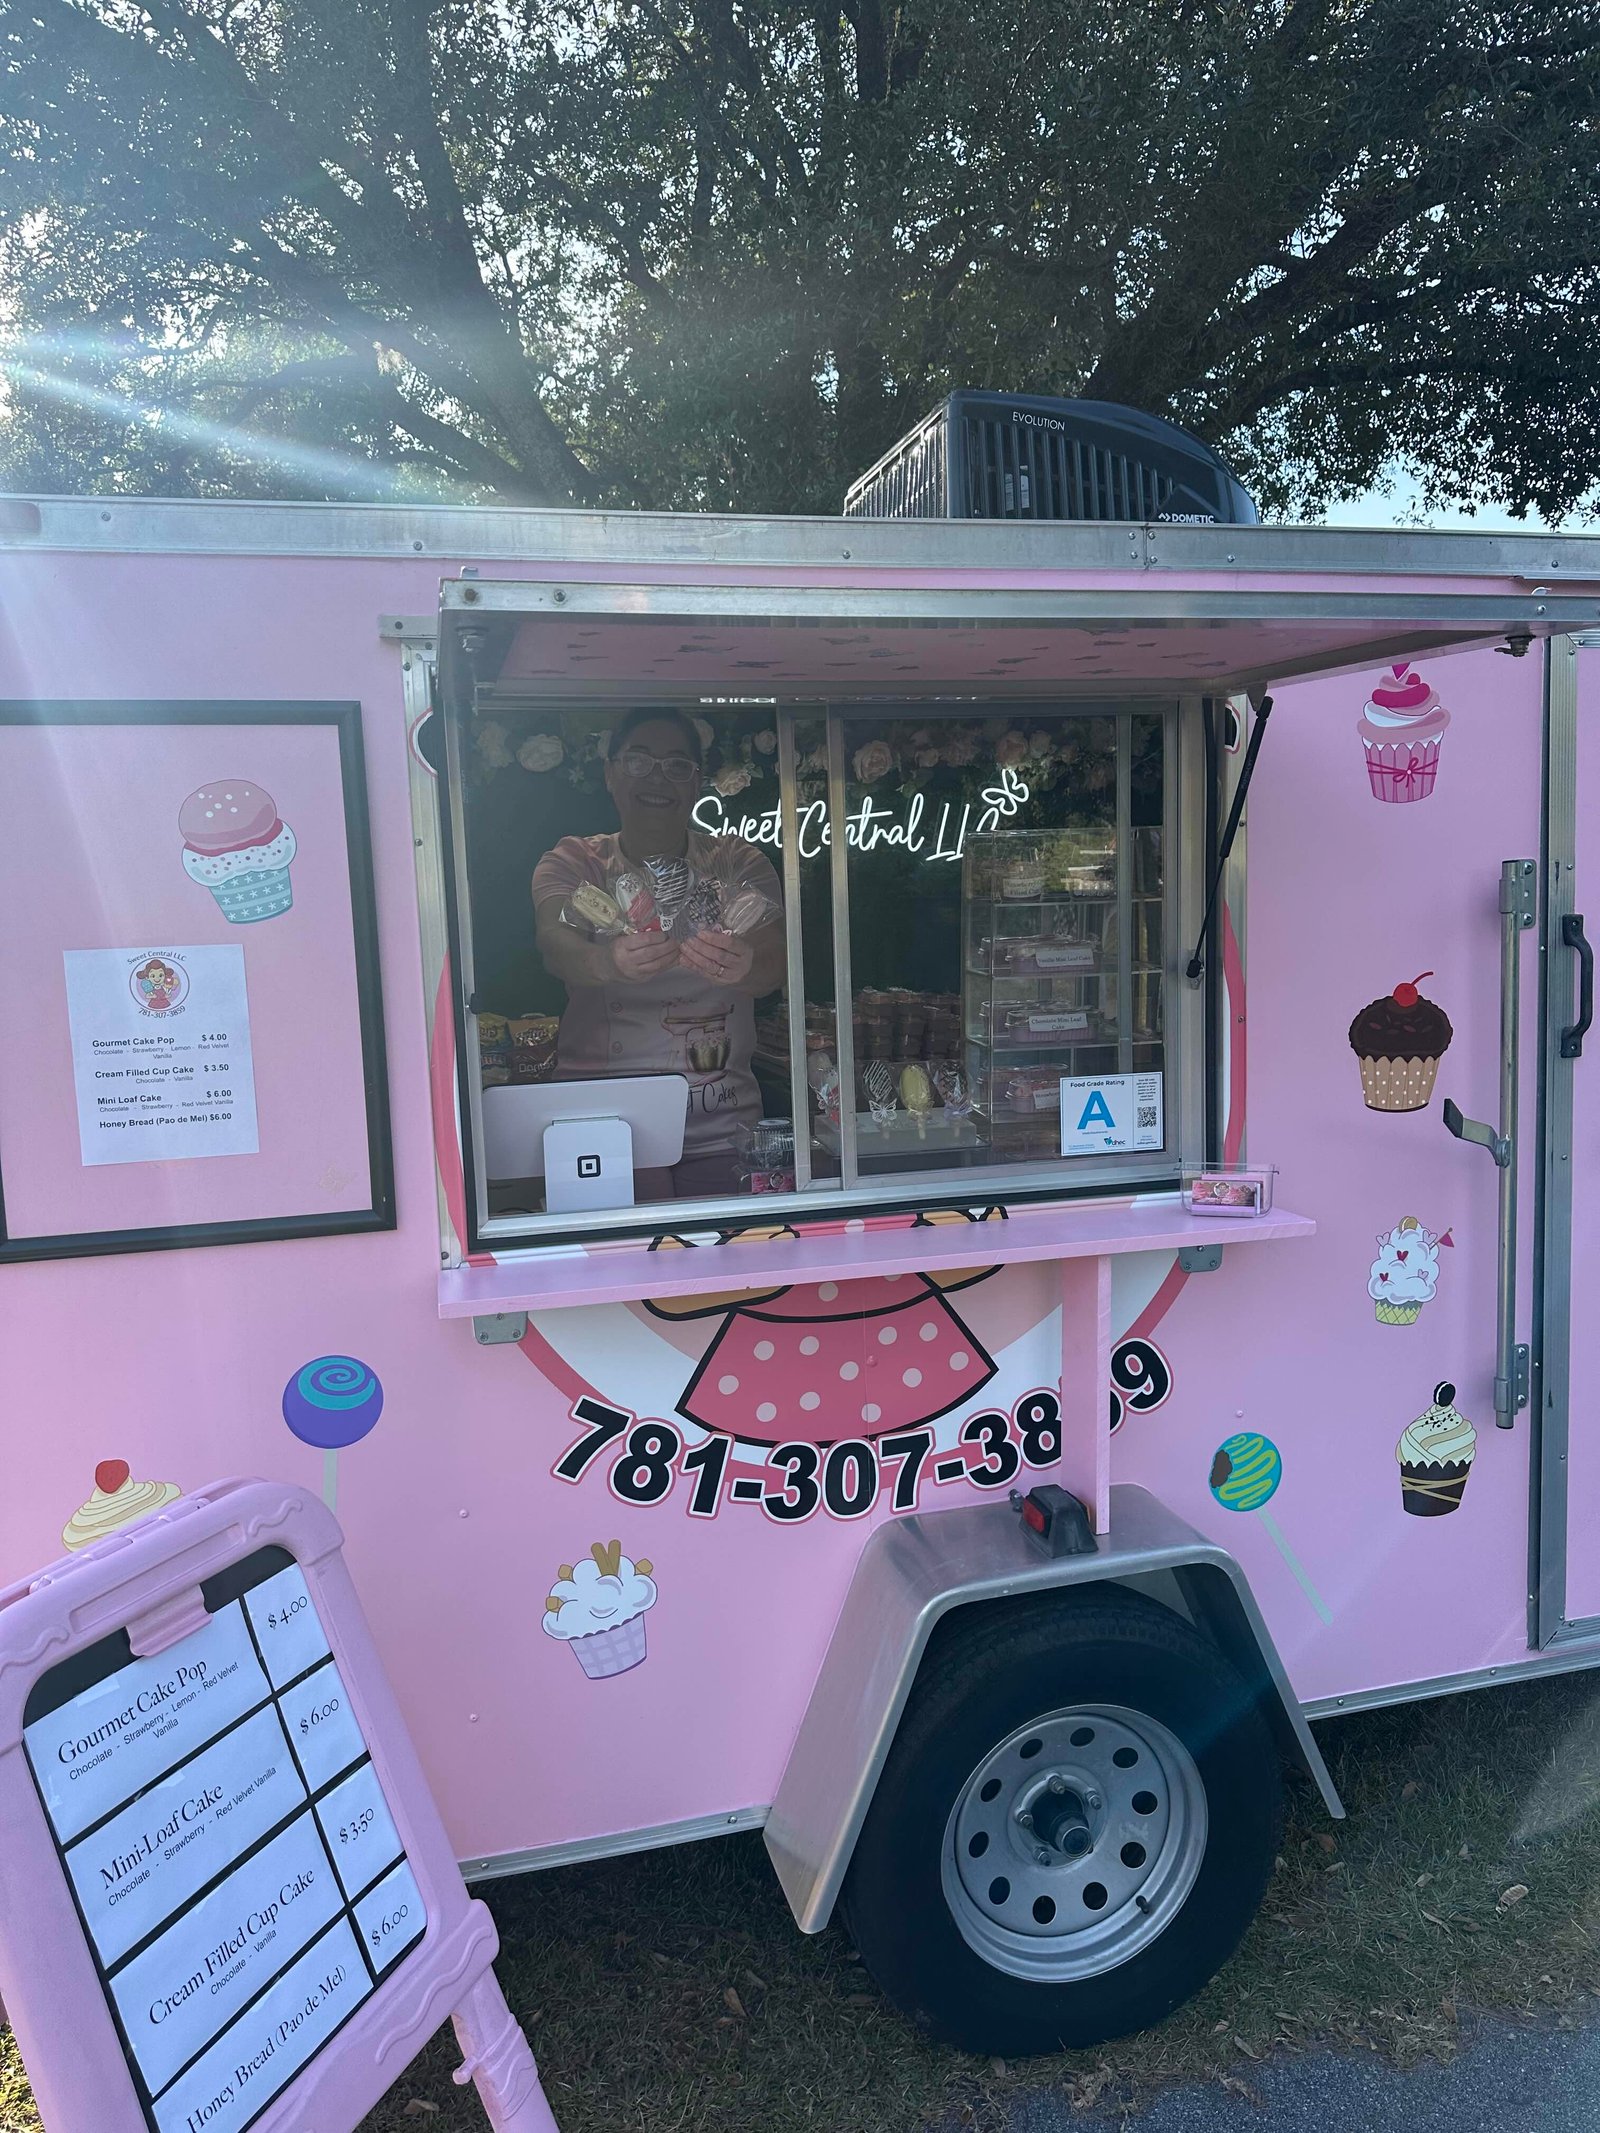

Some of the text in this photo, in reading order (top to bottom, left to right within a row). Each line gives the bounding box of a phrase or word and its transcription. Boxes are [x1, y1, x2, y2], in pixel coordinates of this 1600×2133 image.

[1012, 411, 1065, 431] EVOLUTION
[1172, 513, 1214, 524] DOMETIC
[692, 795, 808, 849] Sweet
[798, 793, 925, 858] Central
[127, 953, 147, 965] Sweet
[173, 952, 187, 962] LLC
[138, 1005, 186, 1019] 781-307-3859
[92, 1039, 131, 1047] Gourmet
[157, 1037, 175, 1045] Pop
[209, 1033, 227, 1041] 4.00
[126, 1068, 150, 1076] Filled
[152, 1068, 170, 1076] Cup
[172, 1066, 194, 1074] Cake
[204, 1065, 209, 1073] $
[97, 1097, 116, 1105] Mini
[118, 1095, 137, 1103] Loaf
[1077, 1091, 1116, 1130] A
[100, 1121, 127, 1129] Honey
[129, 1118, 154, 1126] Bread
[156, 1117, 175, 1126] (Pao
[190, 1114, 207, 1123] Mel)
[210, 1113, 232, 1121] $6.00
[555, 1338, 1171, 1520] 781-307-389
[58, 1596, 308, 1764] Gourmet Cake Pop $ 4.00
[69, 1747, 113, 1781] Chocolate
[123, 1713, 165, 1745] Strawberry
[171, 1691, 197, 1713] Lemon
[202, 1677, 218, 1691] Red
[217, 1661, 239, 1680] Velvet
[152, 1718, 179, 1739] Vanilla
[99, 1699, 339, 1890] Mini-Loaf Cake $ 6.00
[108, 1869, 151, 1906] Chocolate
[163, 1824, 205, 1861] Strawberry
[215, 1803, 233, 1820] Red
[232, 1785, 255, 1805] Velvet
[254, 1766, 277, 1788] Vanilla
[149, 1808, 374, 2025] Cream Filled Cup Cake $ 3.50
[210, 1959, 247, 1995] Chocolate
[253, 1929, 277, 1953] Vanilla
[186, 1904, 409, 2133] Honey Bread (Pao de Mel) $ 6.00
